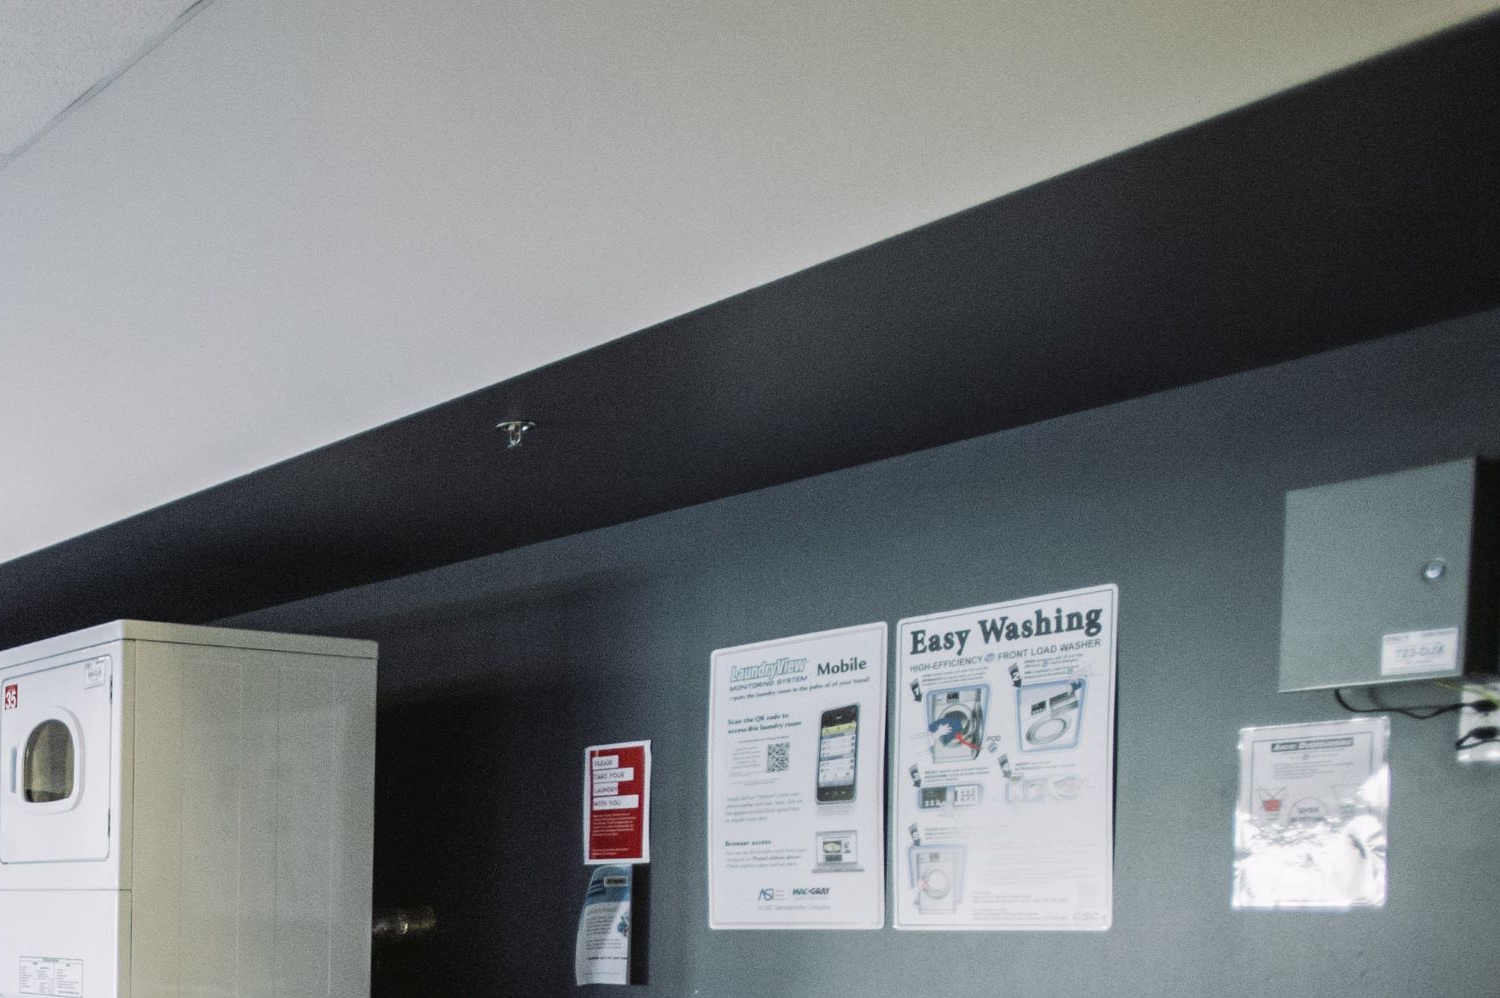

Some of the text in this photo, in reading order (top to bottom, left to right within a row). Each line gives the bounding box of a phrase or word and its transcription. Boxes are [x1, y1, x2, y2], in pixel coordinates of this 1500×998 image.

[909, 607, 1103, 656] Easy Washing
[998, 649, 1028, 661] FRONT
[1031, 646, 1057, 657] LOAD
[1060, 638, 1101, 652] WASHER
[730, 657, 867, 683] LaundryView Mobile
[910, 656, 983, 673] HIGH-EFFICIENCY
[729, 675, 808, 692] MONITORING SYSTEM
[5, 691, 16, 709] 35
[756, 689, 776, 699] laundry
[727, 726, 747, 734] access
[748, 724, 759, 732] this
[760, 722, 783, 732] laundry
[728, 717, 742, 726] Scan
[743, 716, 754, 724] the
